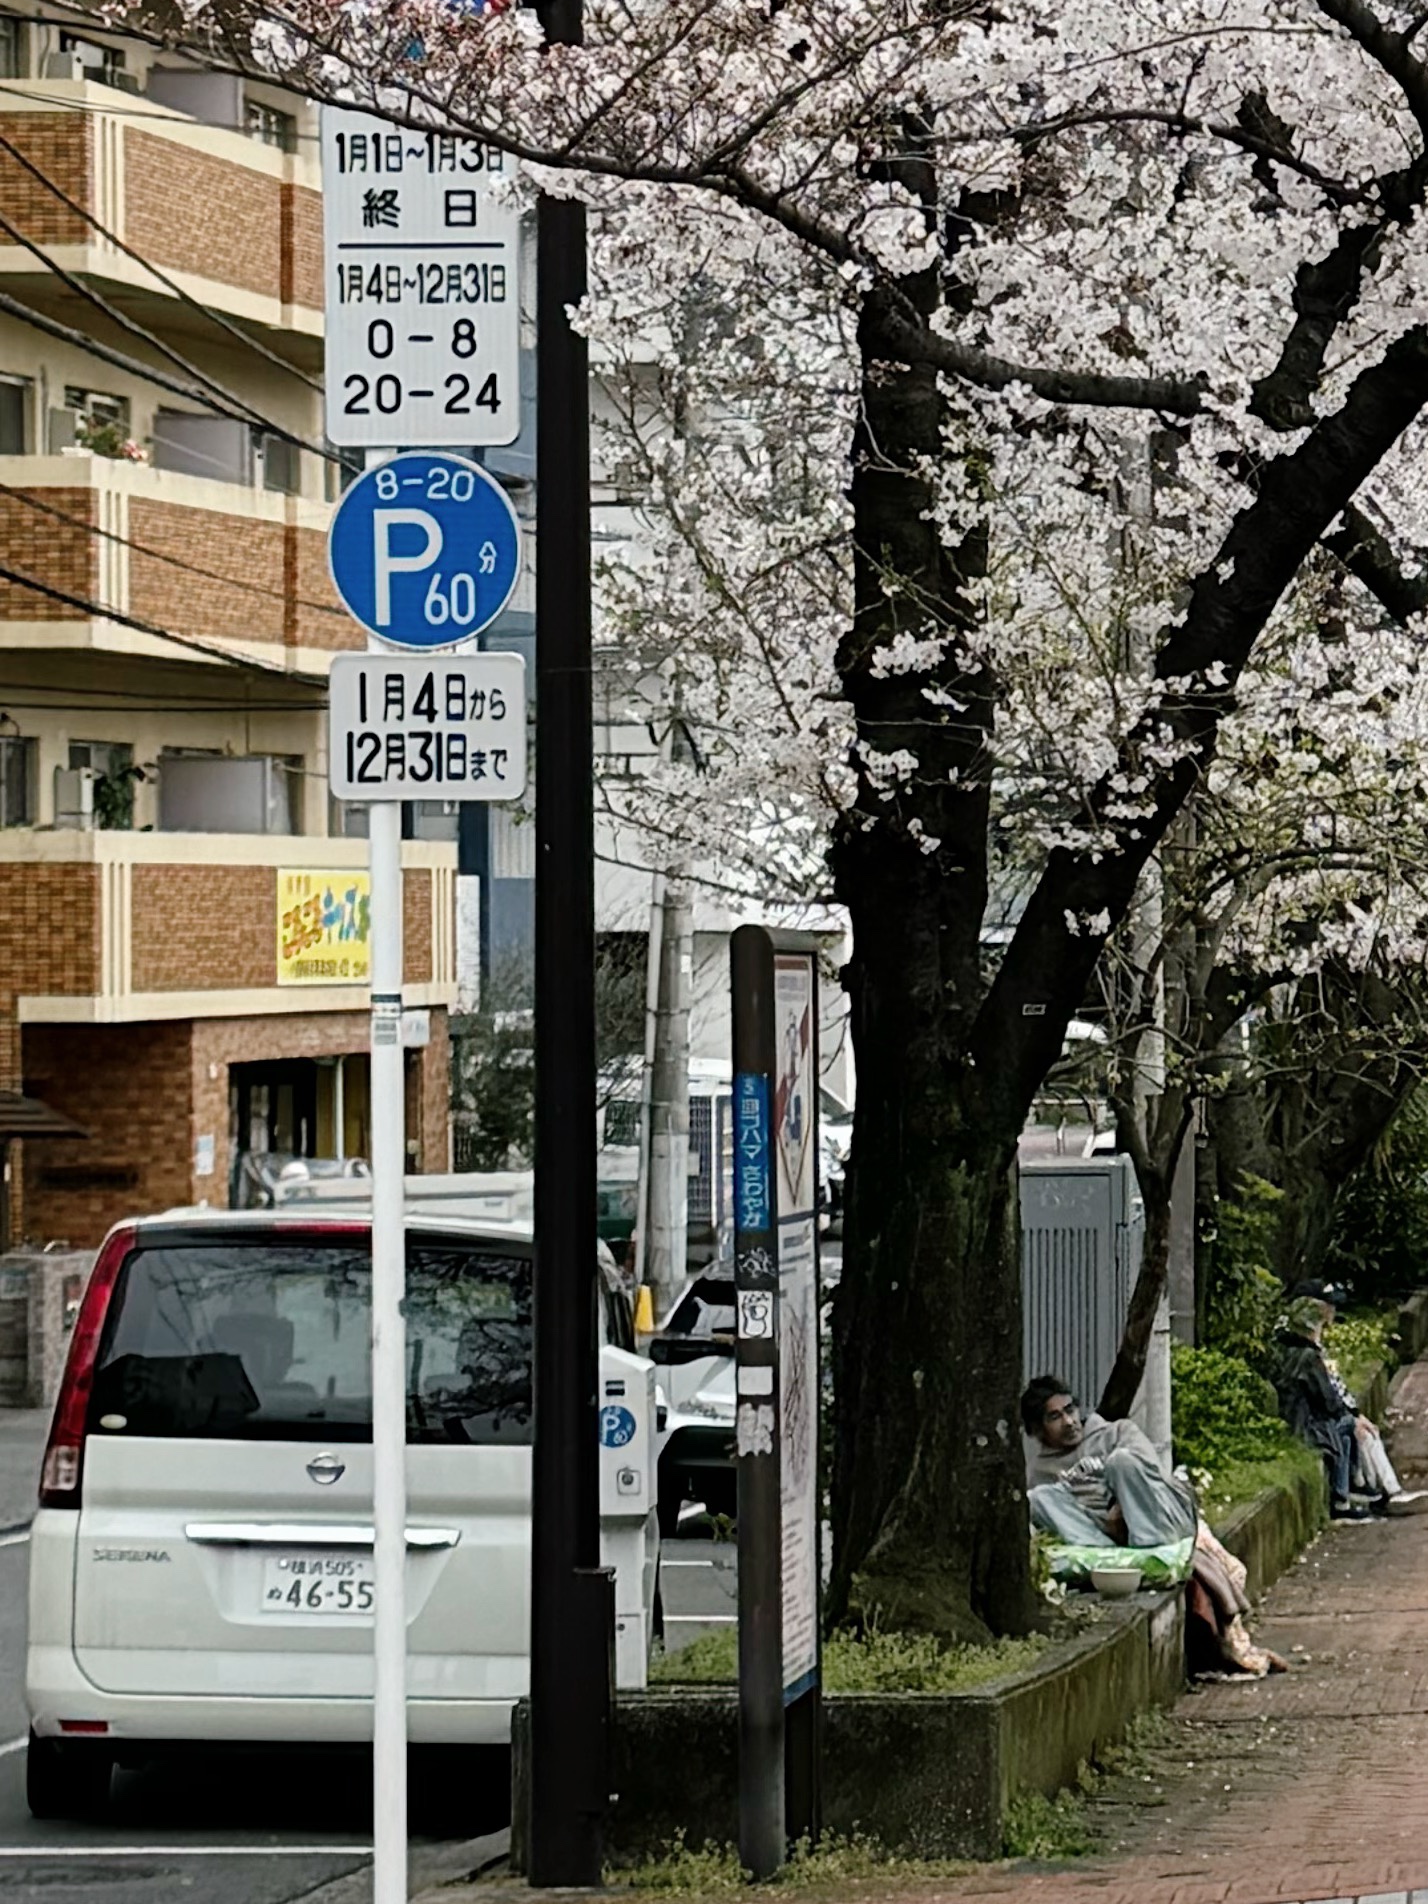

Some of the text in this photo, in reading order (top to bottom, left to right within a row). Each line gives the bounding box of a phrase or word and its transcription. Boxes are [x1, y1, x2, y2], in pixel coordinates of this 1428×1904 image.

[375, 467, 475, 502] 8-20
[373, 508, 444, 626] P
[424, 572, 476, 625] 60
[359, 671, 507, 723] 1月4日から
[347, 731, 508, 783] 12月31日まで
[286, 1579, 374, 1609] 46-55
